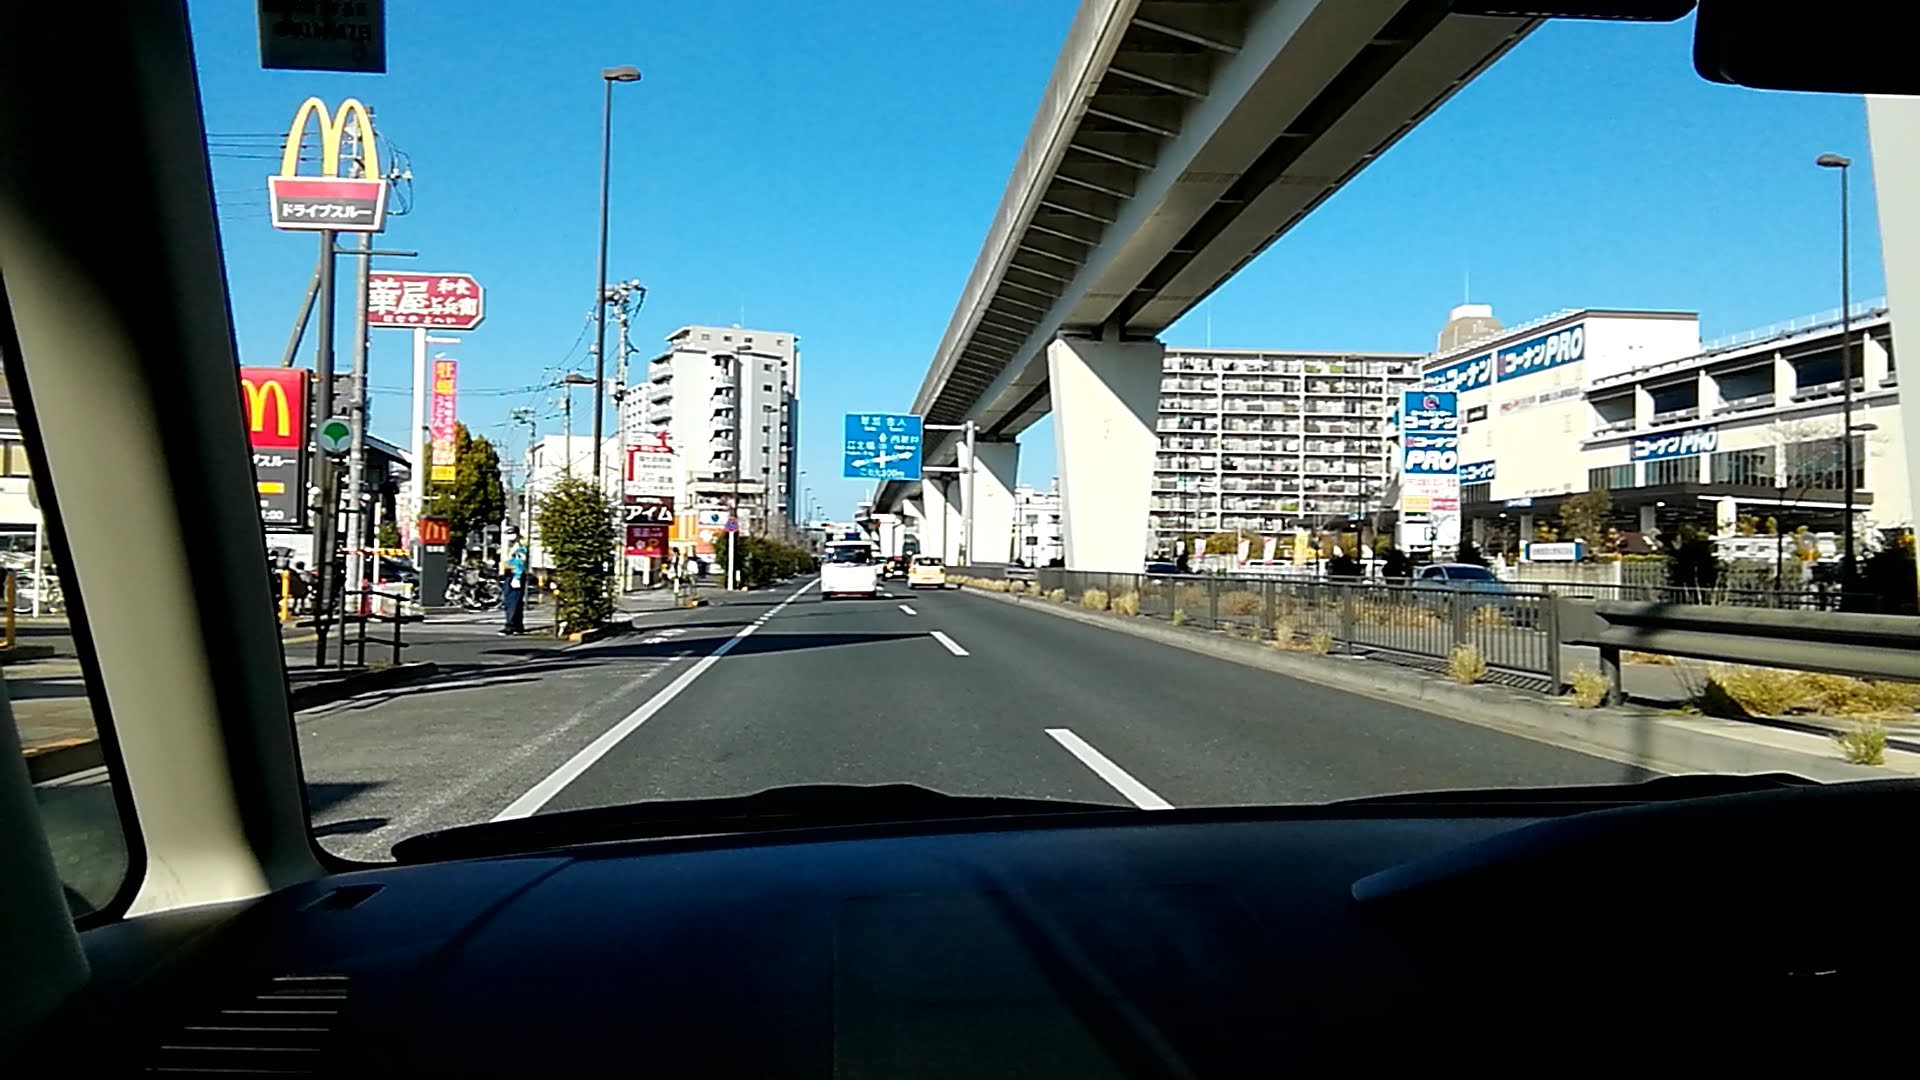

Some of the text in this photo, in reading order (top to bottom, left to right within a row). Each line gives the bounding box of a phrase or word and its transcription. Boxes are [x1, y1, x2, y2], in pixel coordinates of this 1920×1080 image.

[282, 204, 372, 218] ドライブスルー
[437, 278, 471, 295] 和食
[1504, 327, 1583, 373] コーナンPRO
[1404, 416, 1458, 429] コーナン
[1413, 437, 1458, 448] コーナン
[1634, 427, 1718, 457] コーナンPRO
[1405, 450, 1457, 471] PRO
[625, 505, 673, 521] アイム
